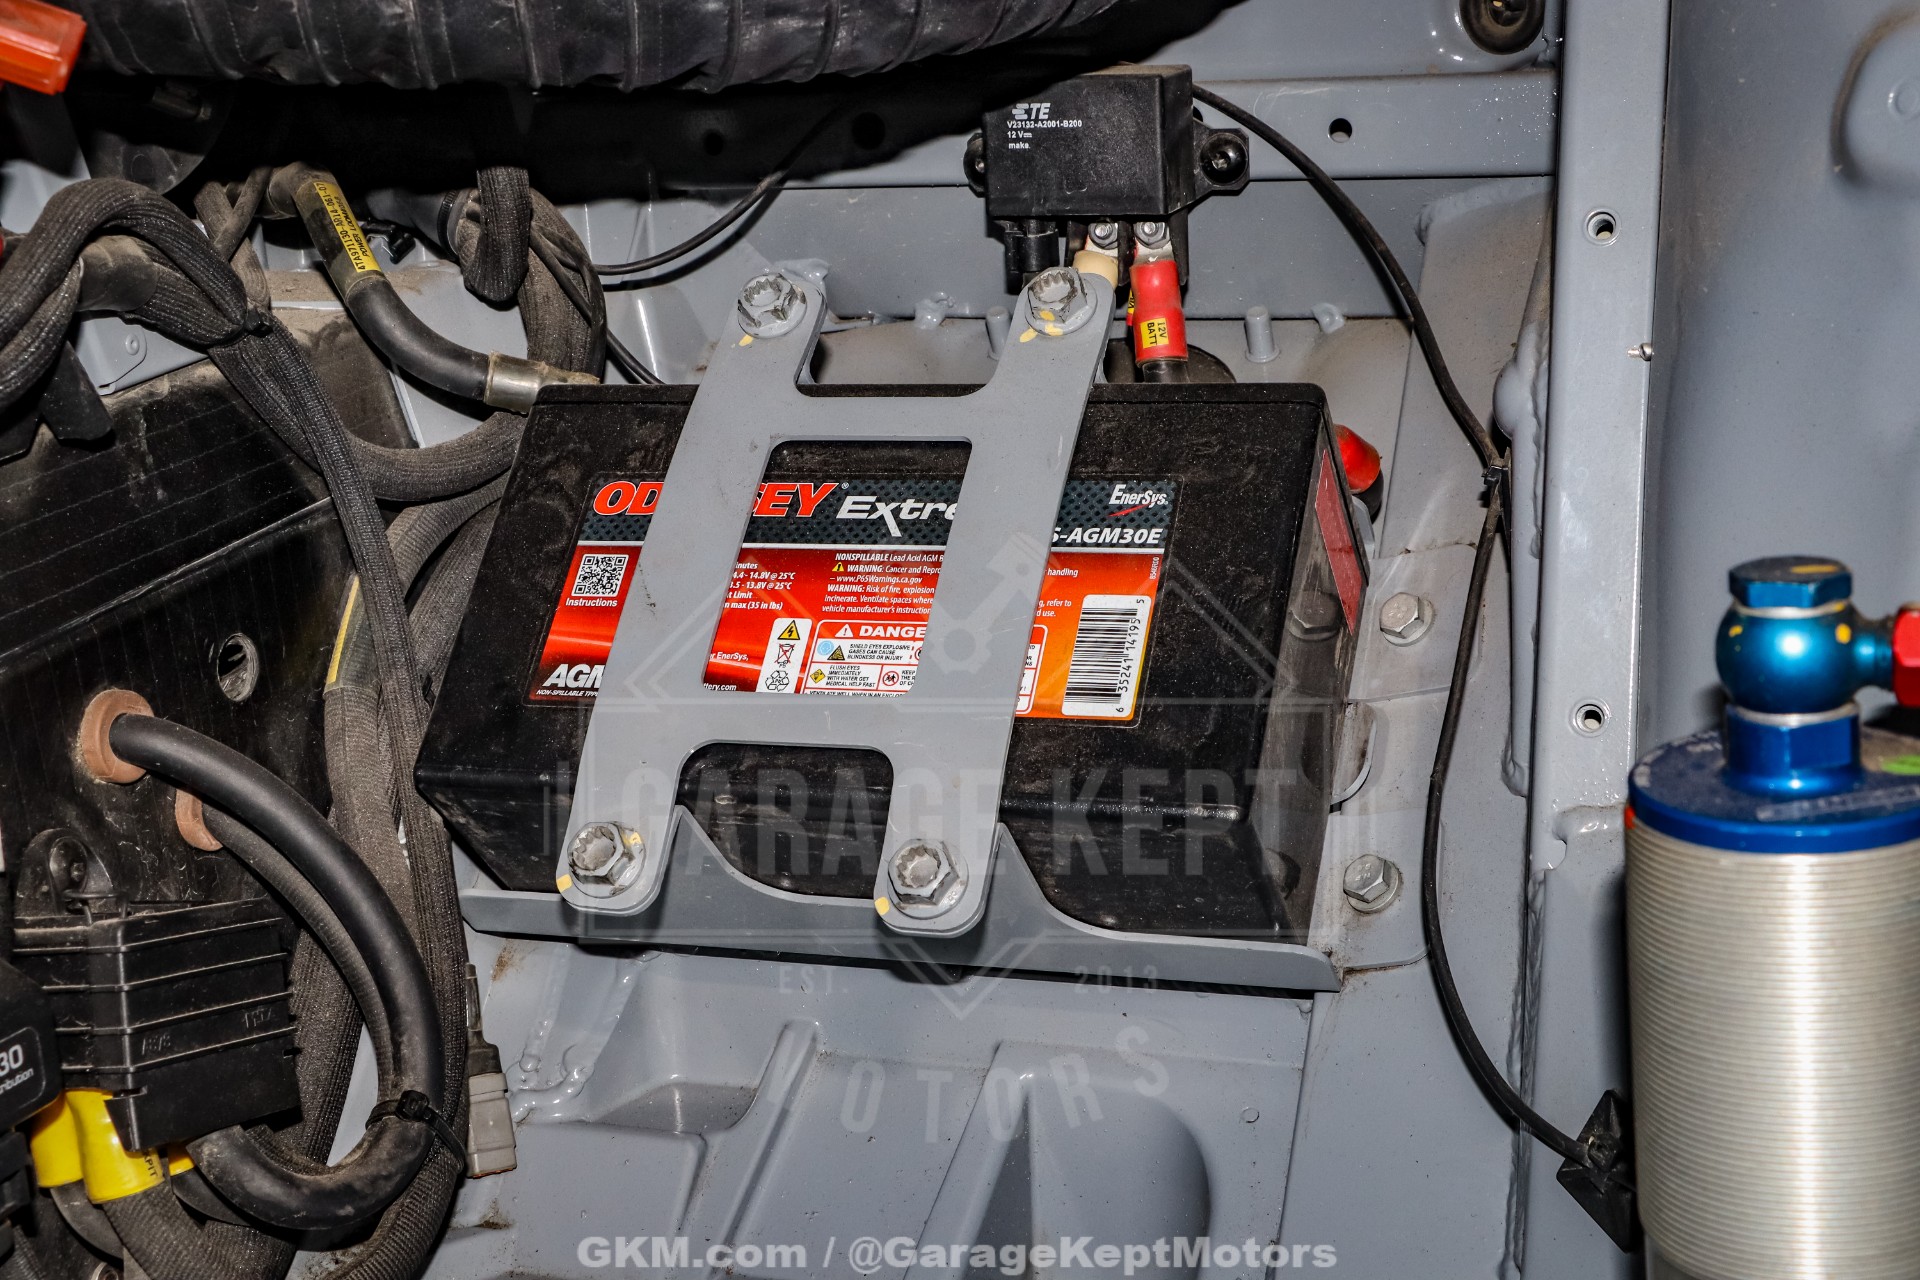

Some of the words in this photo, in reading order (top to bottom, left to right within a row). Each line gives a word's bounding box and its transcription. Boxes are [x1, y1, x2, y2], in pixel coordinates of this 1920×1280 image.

[1030, 102, 1051, 120] TE
[1006, 120, 1083, 128] V23132-A2001-B200
[1007, 130, 1017, 138] 12
[1147, 322, 1158, 346] BATT
[1157, 322, 1168, 338] 12V
[1108, 484, 1167, 508] EnerSys
[835, 552, 890, 562] NONSPILLABLE
[890, 554, 906, 562] Lead
[907, 554, 921, 562] Acid
[922, 554, 938, 562] AGM
[847, 564, 884, 573] WARNING:
[886, 565, 907, 573] Cancer
[908, 566, 921, 574] and
[1048, 568, 1078, 578] handling
[750, 572, 770, 580] 14.8V
[827, 584, 866, 592] WARNING:
[880, 584, 888, 593] of
[566, 598, 618, 607] Instructions
[824, 594, 858, 602] incinerate.
[860, 595, 888, 603] Ventilate
[1046, 598, 1063, 606] refer
[748, 602, 760, 610] (35
[769, 602, 783, 610] lbs)
[822, 604, 845, 612] vehicle
[716, 652, 748, 662] EnerSys,
[1117, 658, 1134, 692] 35241
[1126, 618, 1140, 650] 14195
